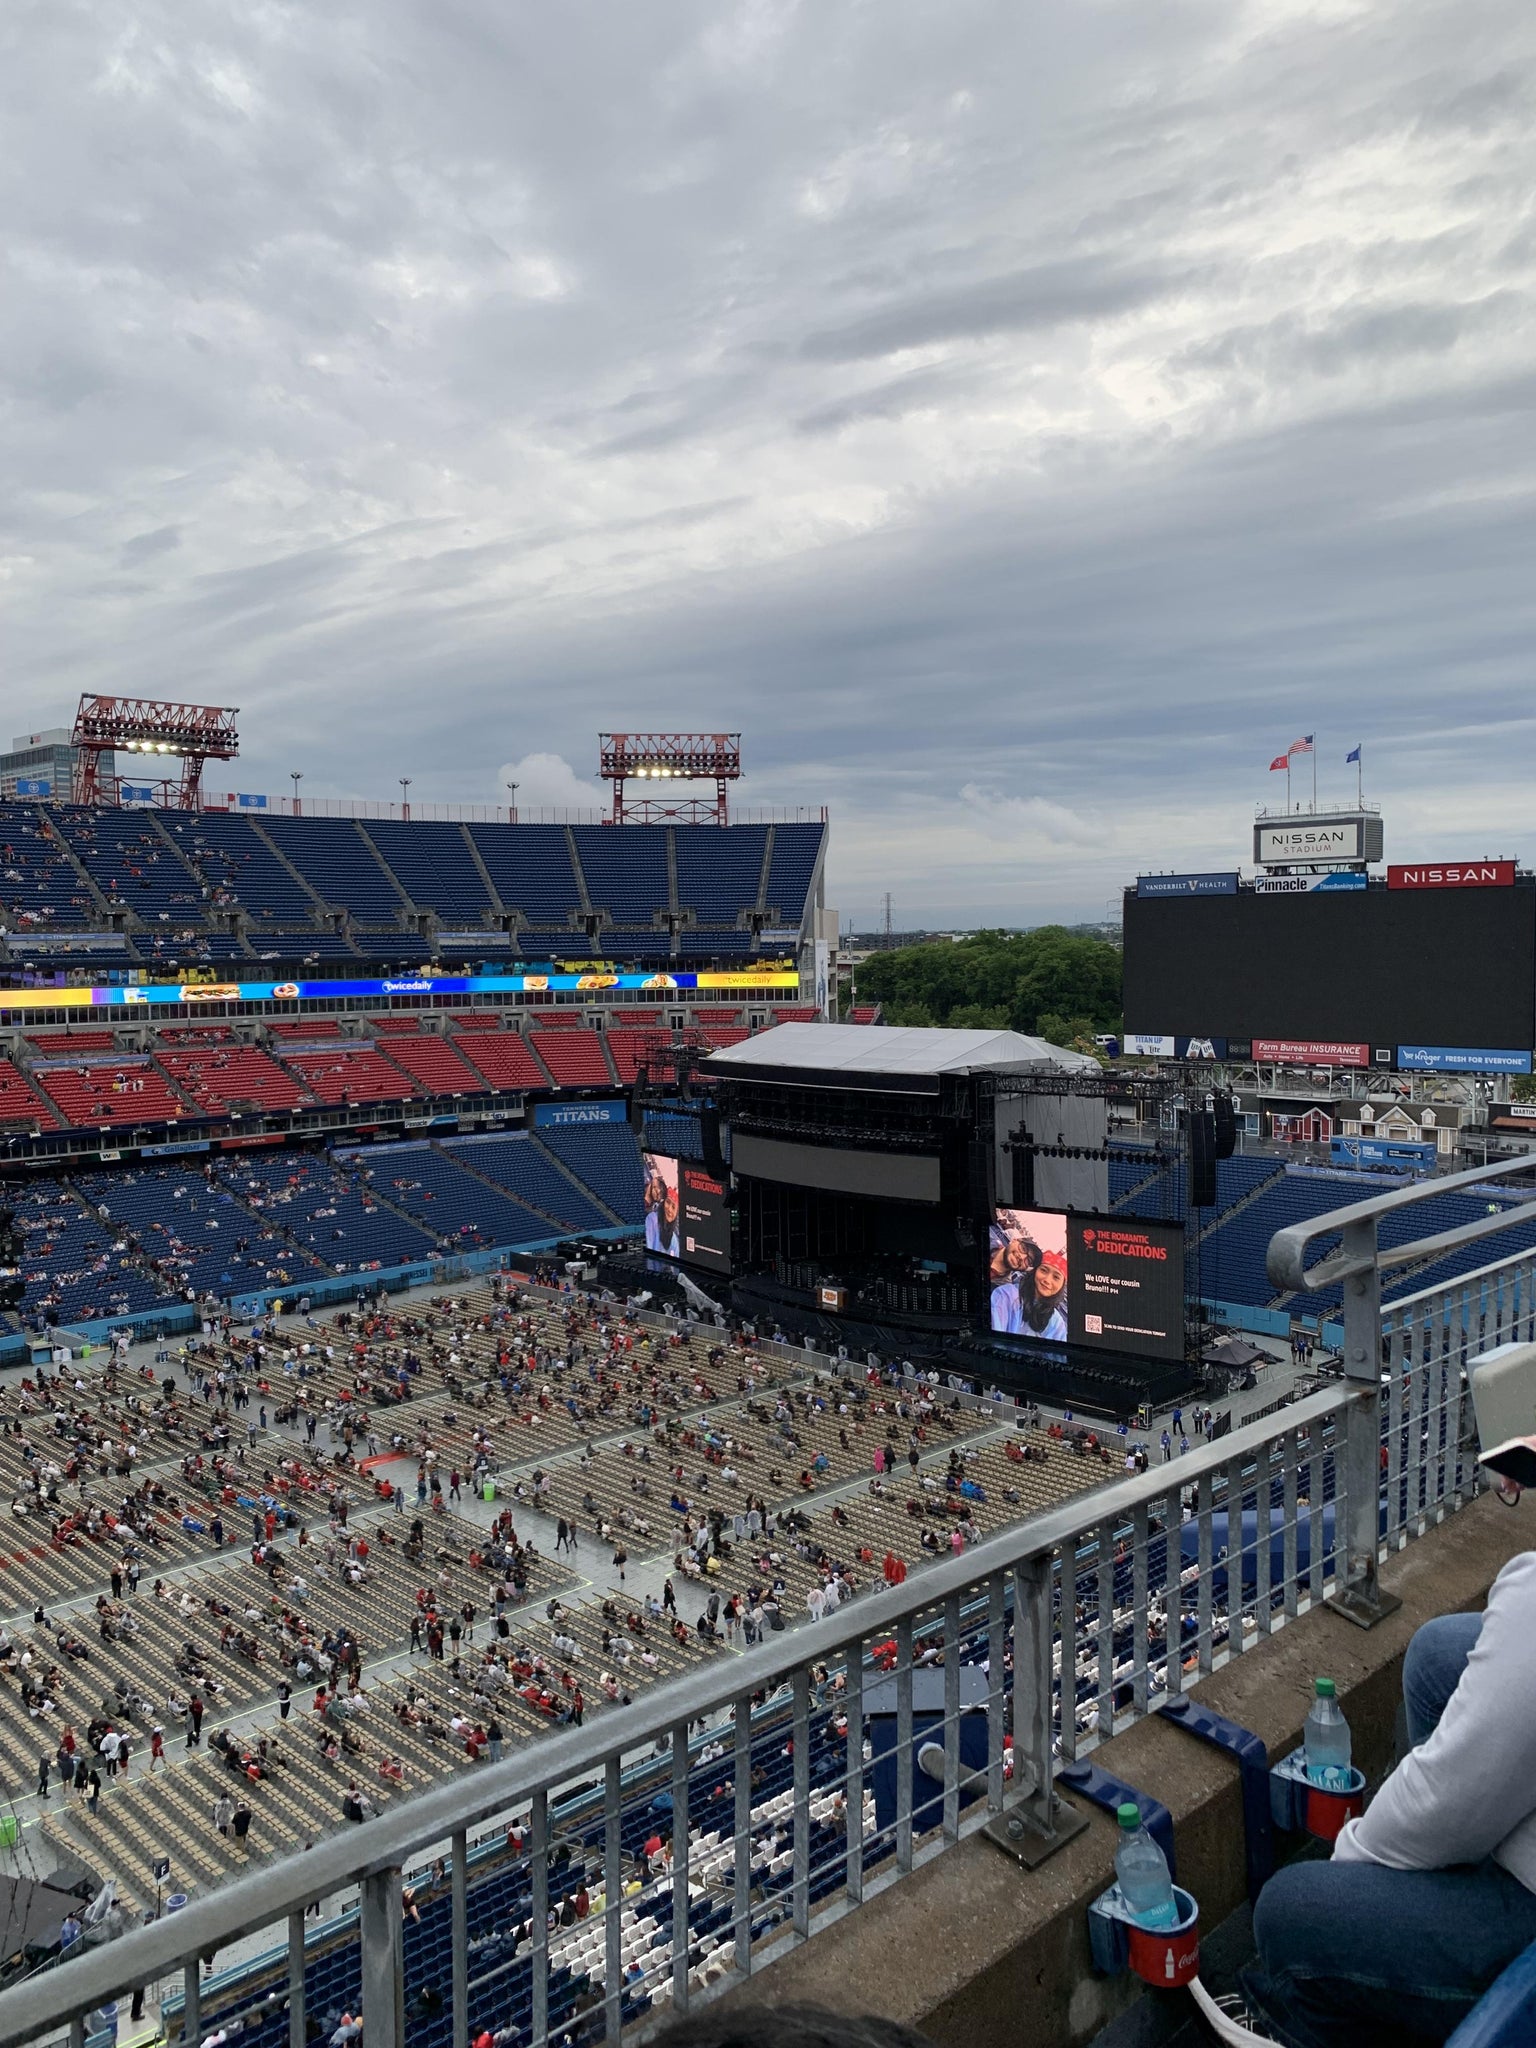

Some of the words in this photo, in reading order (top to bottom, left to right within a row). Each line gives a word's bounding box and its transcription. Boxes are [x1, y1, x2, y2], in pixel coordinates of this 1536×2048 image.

[1272, 832, 1344, 845] NISSAN
[1283, 844, 1332, 854] STADIUM
[1403, 868, 1497, 884] NISSAN
[1145, 883, 1187, 891] VANDERBILT
[1256, 878, 1308, 892] Pinnacle
[382, 981, 433, 993] twicedaily
[727, 977, 771, 985] twicedaily
[1149, 1045, 1160, 1053] Lite
[1259, 1043, 1278, 1051] Farm
[1280, 1043, 1308, 1052] Bureau
[1310, 1045, 1360, 1055] INSURANCE
[1414, 1050, 1441, 1066] Kroger
[1445, 1055, 1466, 1063] FRESH
[552, 1110, 610, 1123] TITANS
[1097, 1230, 1110, 1240] THE
[1111, 1232, 1149, 1244] ROMANTIC
[1097, 1241, 1167, 1260] DEDICATIONS
[1085, 1273, 1095, 1281] We
[1095, 1274, 1110, 1283] LOVE
[1121, 1280, 1140, 1288] cousin
[1085, 1283, 1109, 1293] Bruno!!!
